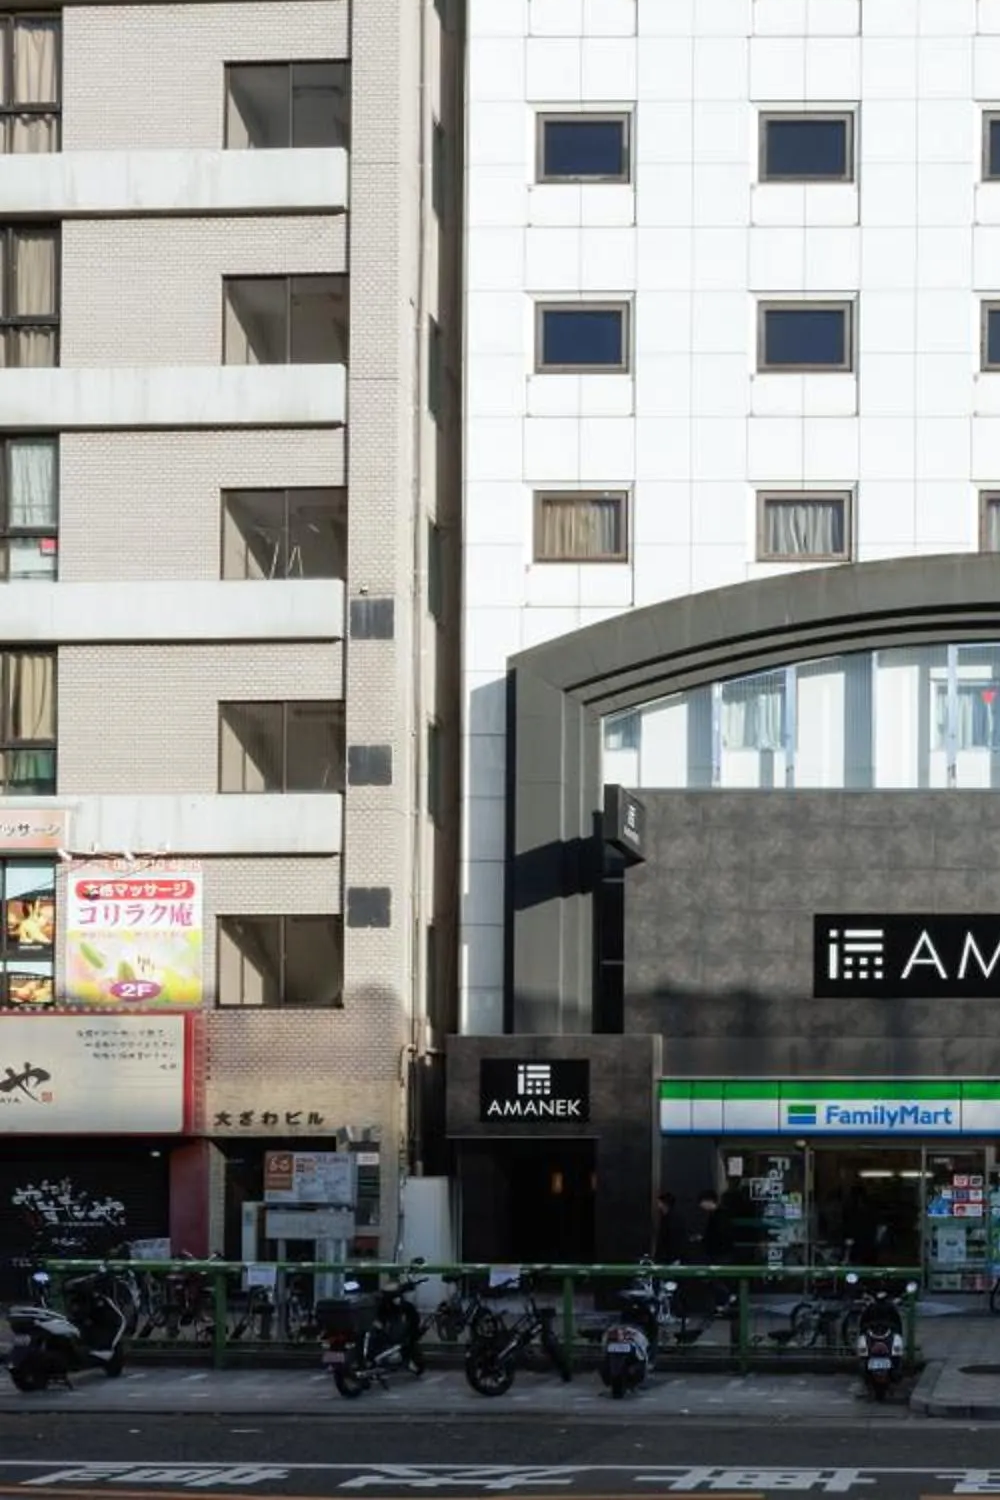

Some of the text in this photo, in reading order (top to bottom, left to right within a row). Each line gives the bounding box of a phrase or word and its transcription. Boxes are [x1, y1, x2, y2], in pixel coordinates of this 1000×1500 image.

[0, 823, 62, 838] ッサージ
[120, 983, 153, 997] 2F
[487, 1099, 581, 1116] AMANEK
[826, 1104, 953, 1127] FamilyMart
[213, 1110, 325, 1127] 大ざわビル
